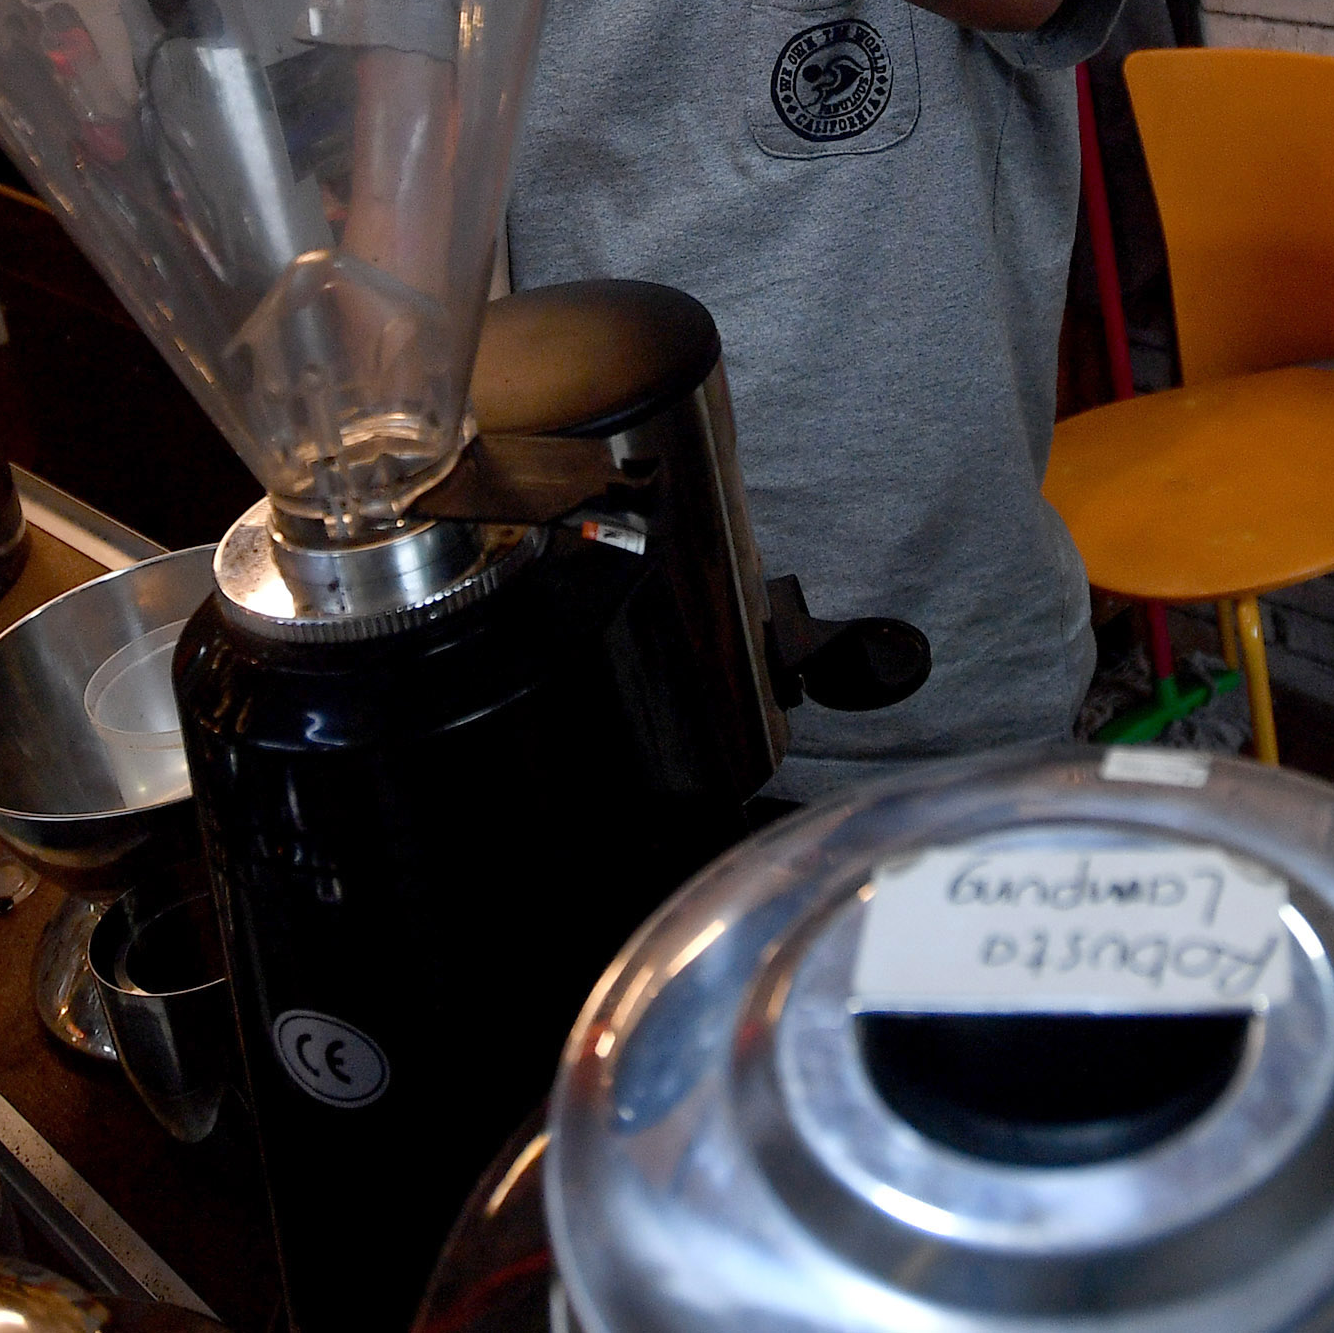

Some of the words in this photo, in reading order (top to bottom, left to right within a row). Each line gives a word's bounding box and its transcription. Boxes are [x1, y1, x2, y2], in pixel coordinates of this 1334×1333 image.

[787, 35, 818, 65] OWN
[853, 25, 888, 75] WORLD
[794, 97, 882, 134] CALIFORNIA
[946, 850, 1228, 929] Lampung
[979, 930, 1281, 999] Robusta
